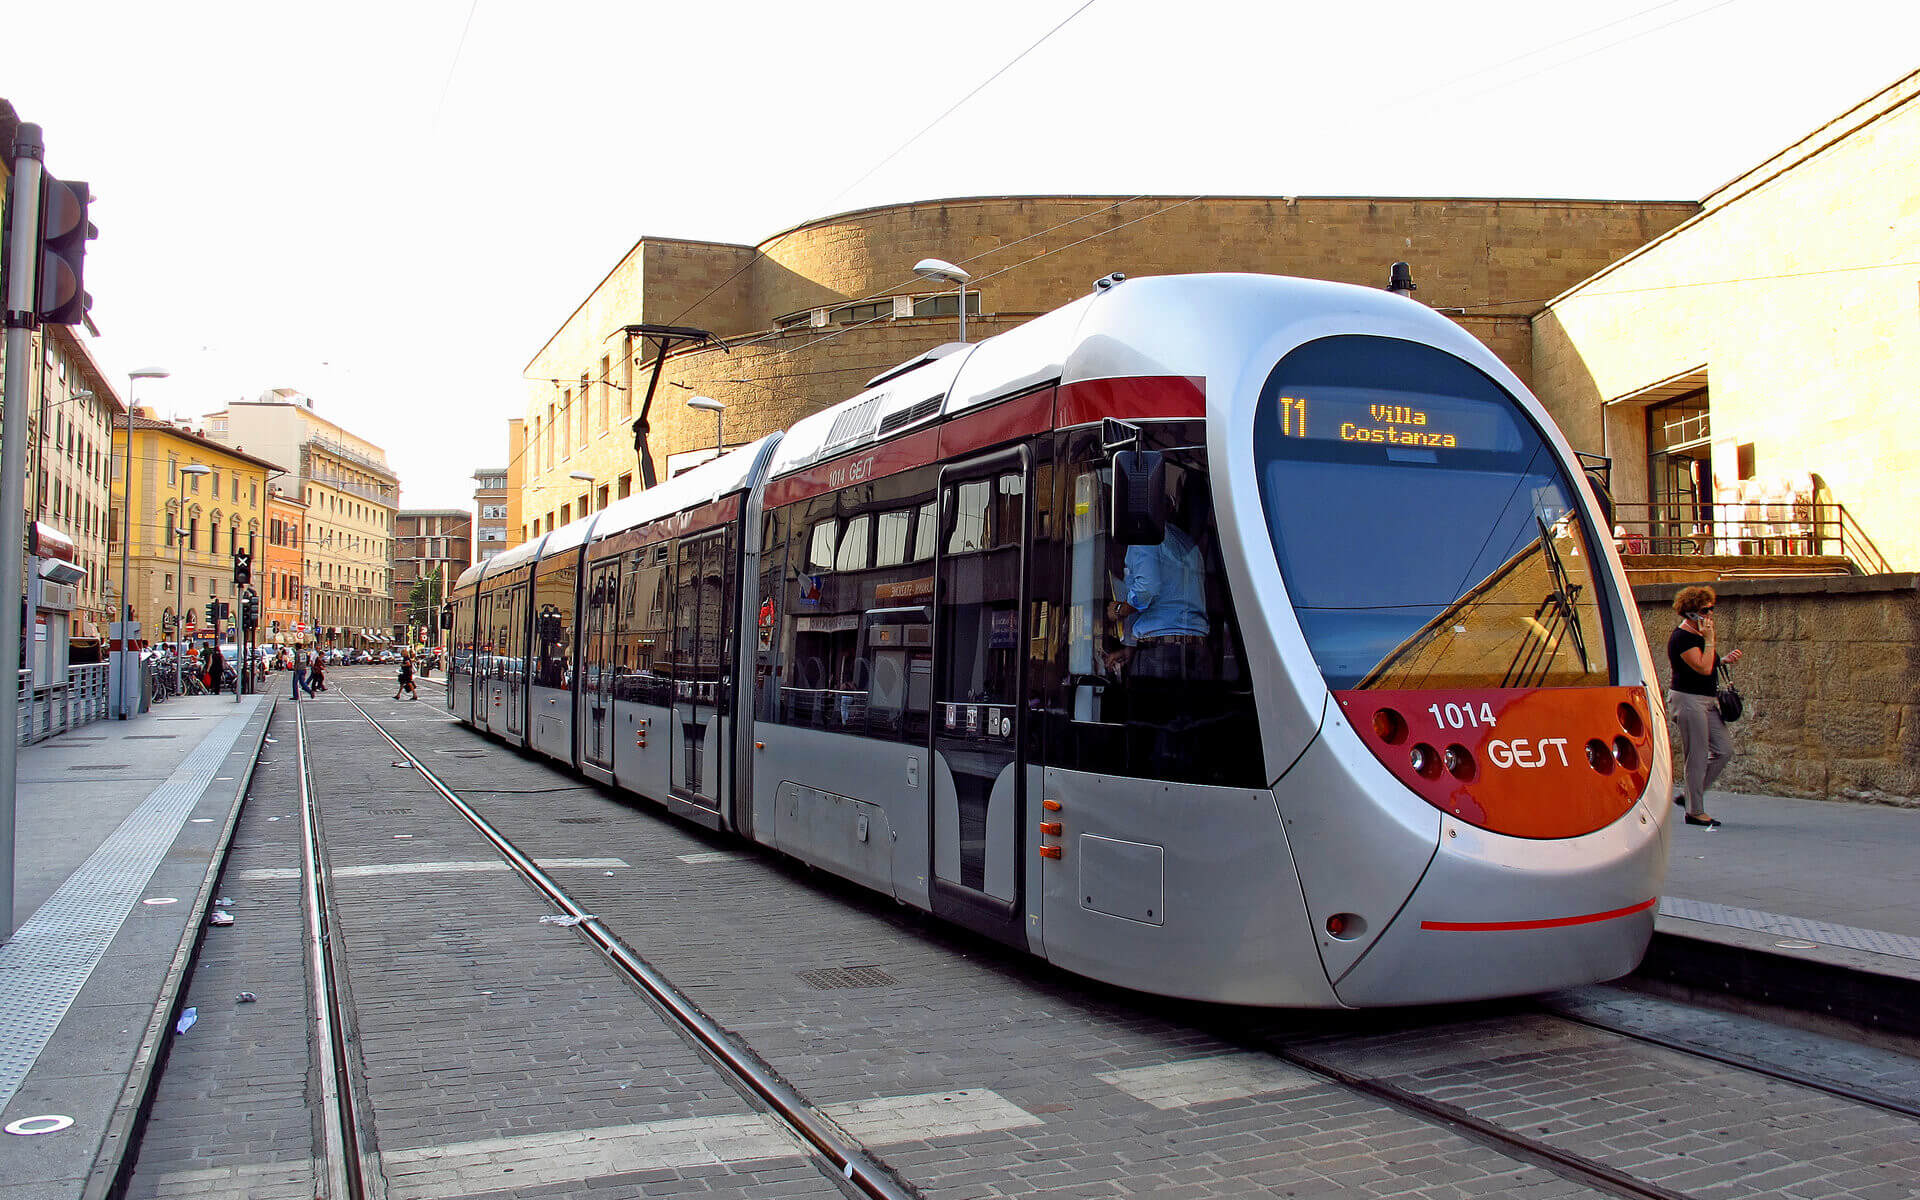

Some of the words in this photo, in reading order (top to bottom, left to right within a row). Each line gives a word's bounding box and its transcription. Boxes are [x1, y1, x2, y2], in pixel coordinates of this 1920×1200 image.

[1280, 397, 1307, 437] T1
[1370, 404, 1427, 425] Villa
[1341, 423, 1456, 447] Costanza
[829, 468, 845, 487] 1014
[850, 456, 874, 480] GEST
[1428, 702, 1497, 729] 1014
[1487, 738, 1569, 769] GEST
